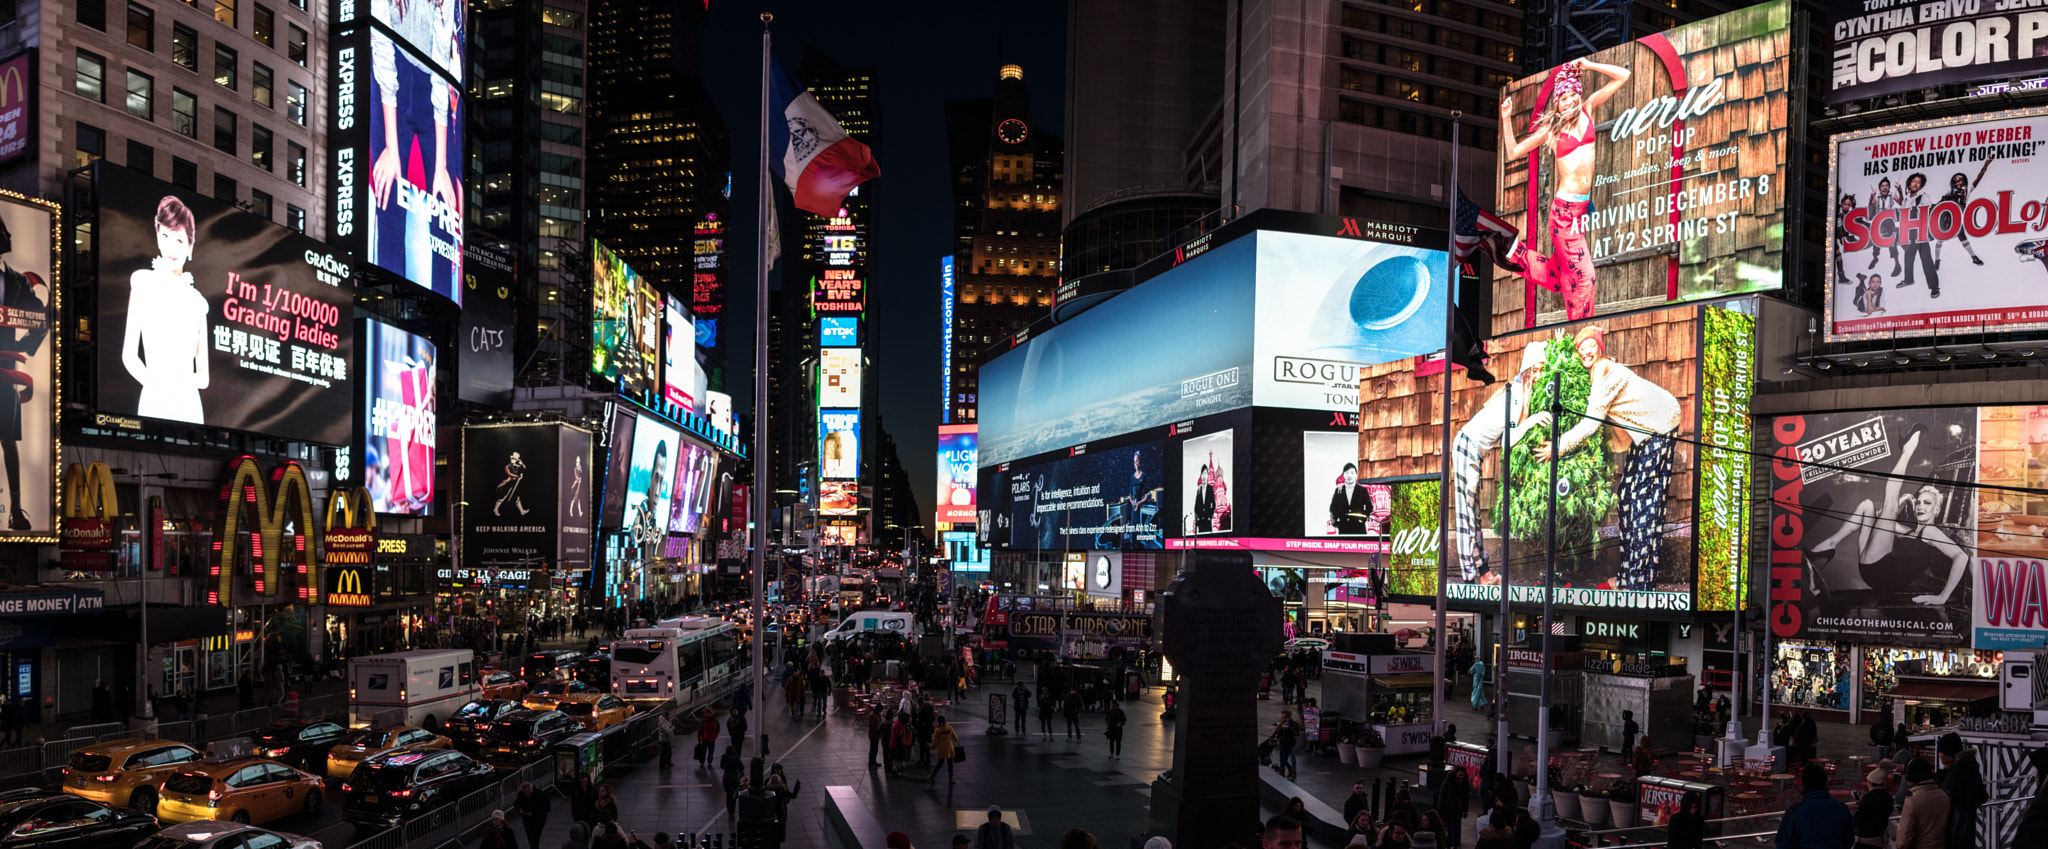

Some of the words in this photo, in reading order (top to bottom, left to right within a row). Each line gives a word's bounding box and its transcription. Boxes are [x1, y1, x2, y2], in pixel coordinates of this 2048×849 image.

[1834, 7, 1914, 41] CYNTHIA
[1919, 0, 1980, 24] ERIVO
[1857, 16, 2010, 84] COLOR
[1832, 41, 1858, 91] THE
[338, 48, 354, 130] EXPRESS
[1611, 70, 1726, 142] aerie
[1636, 127, 1696, 158] POP-UP
[1929, 131, 1972, 151] LLOYD
[1976, 125, 2032, 145] WEBBER
[1594, 174, 1620, 188] Bras,
[1624, 162, 1661, 180] undies,
[1664, 155, 1692, 172] sleep
[1694, 149, 1706, 162] &
[1709, 144, 1740, 160] more.
[1864, 159, 1889, 176] HAS
[1892, 150, 1966, 172] BROADWAY
[337, 148, 353, 236] EXPRESS
[1570, 199, 1648, 236] ARRIVING
[1655, 178, 1751, 216] DECEMBER
[1758, 174, 1769, 195] 8
[1367, 221, 1419, 235] MARRIOTT
[1843, 190, 2028, 253] SCHOOL
[832, 236, 854, 251] 16
[1186, 233, 1212, 250] MARRIOTT
[1367, 230, 1413, 243] MARQUIS
[1593, 237, 1612, 260] AT
[1617, 231, 1636, 257] 72
[1641, 215, 1709, 249] SPRING
[1716, 210, 1740, 234] ST
[1185, 243, 1209, 259] MARQUIS
[825, 270, 855, 280] NEW
[818, 280, 861, 290] YEAR'S
[226, 271, 258, 302] I'm
[262, 284, 340, 327] 1/100000
[828, 290, 851, 300] EVE
[7, 308, 19, 317] SEE
[815, 302, 863, 311] TOSHIBA
[7, 316, 41, 329] JANUARY
[223, 297, 291, 341] Gracing
[294, 317, 339, 350] ladies
[1929, 314, 1951, 325] WINTER
[1953, 312, 1975, 324] GARDEN
[1978, 311, 2002, 322] THEATRE
[471, 326, 503, 352] CATS
[1737, 331, 1748, 346] ST
[214, 325, 281, 364] 世界见证
[291, 345, 347, 380] 百年优雅
[1183, 377, 1213, 396] ROGUE
[1216, 371, 1237, 386] ONE
[1735, 351, 1747, 400] SPRING
[1195, 394, 1222, 409] TONIGHT
[1735, 403, 1746, 419] 72
[1713, 387, 1730, 459] POP-UP
[1734, 421, 1746, 438] AT
[1800, 442, 1826, 465] 20
[1825, 423, 1883, 455] YEARS
[1841, 446, 1883, 467] WORLDWIDE
[1011, 480, 1030, 495] POLARIS
[476, 525, 490, 533] KEEP
[492, 525, 518, 533] WALKING
[520, 525, 546, 533] AMERICA
[1770, 415, 1806, 638] CHICAGO
[325, 533, 373, 545] McDonald's
[1286, 541, 1301, 549] STEP
[1302, 541, 1324, 549] INSIDE.
[1324, 541, 1340, 549] SNAP
[1340, 542, 1357, 550] YOUR
[1358, 542, 1379, 550] PHOTO.
[482, 547, 510, 555] JOHNNIE
[1411, 558, 1436, 566] AERIE.COM
[1447, 583, 1521, 602] AMERICN
[1578, 589, 1690, 611] OUTFITTERS
[1981, 559, 2048, 628] WA
[27, 598, 71, 612] MONEY
[78, 596, 103, 609] ATM
[1024, 615, 1056, 634] STAR
[1075, 616, 1147, 637] AIRBORNE
[1585, 621, 1639, 639] DRINK
[1816, 616, 1954, 631] CHICAGOTHEMUSICAL.COM
[1508, 650, 1543, 664] IRGIL'
[2002, 714, 2031, 733] BOX
[1641, 788, 1674, 804] JERSEY
